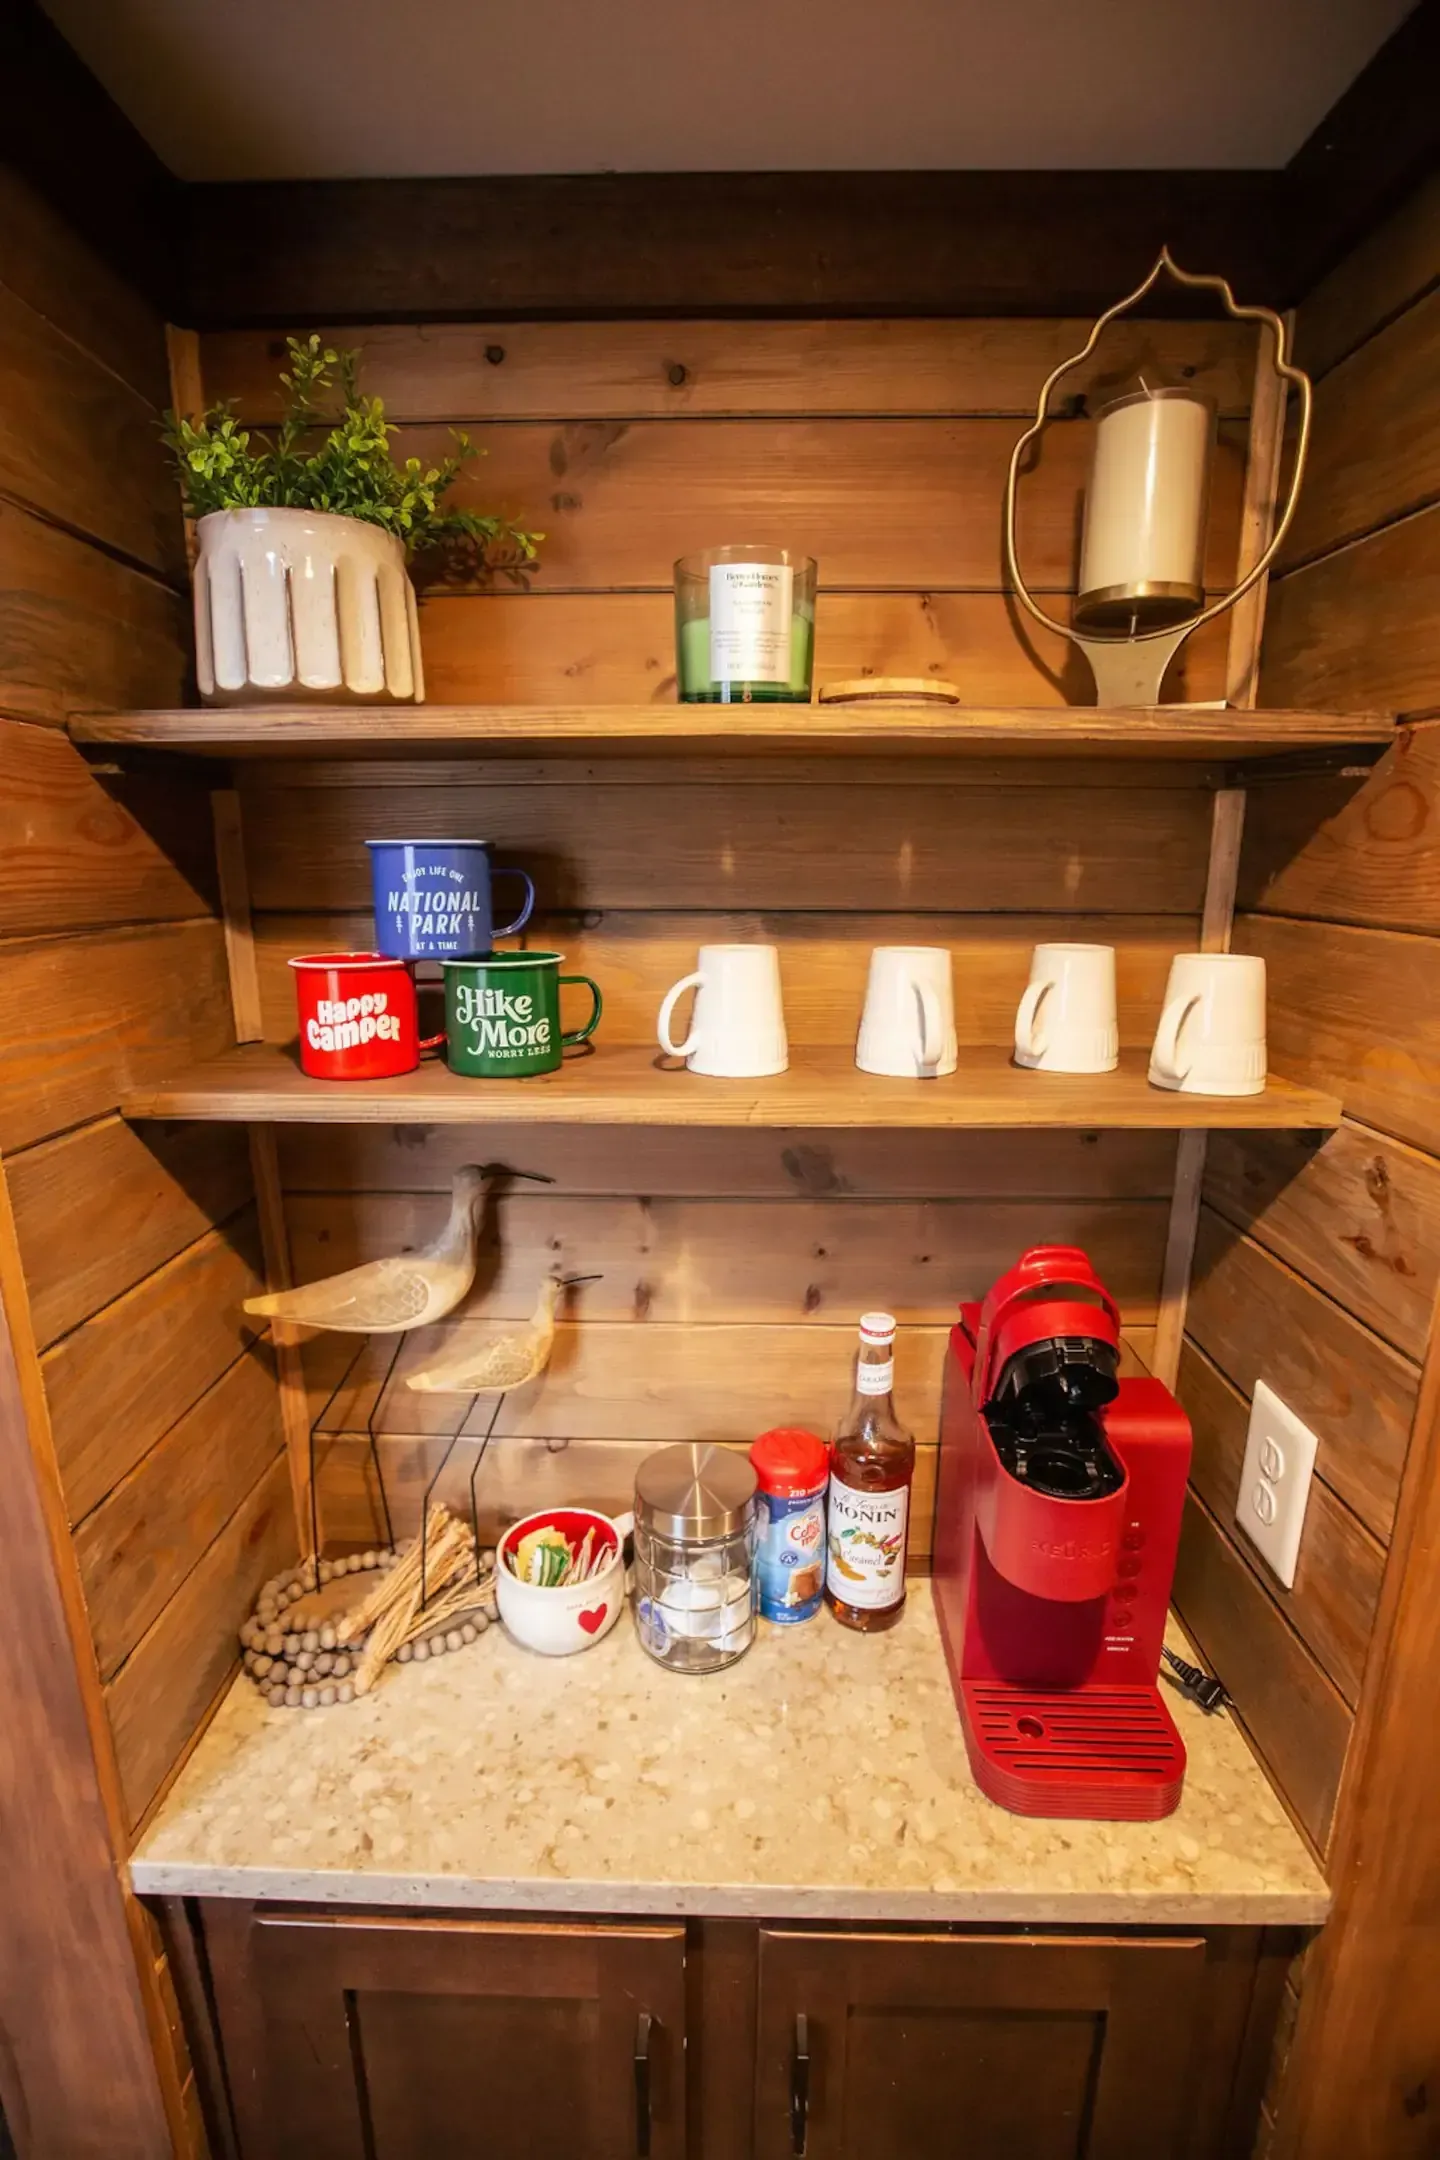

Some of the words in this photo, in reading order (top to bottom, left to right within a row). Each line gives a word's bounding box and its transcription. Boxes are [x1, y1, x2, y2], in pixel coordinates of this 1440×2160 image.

[429, 866, 447, 877] LIFE
[388, 891, 480, 912] NATIONAL
[411, 914, 463, 934] PARK
[438, 941, 458, 950] TIME
[317, 993, 388, 1025] Happy
[456, 985, 533, 1024] Hike
[306, 1014, 401, 1052] Camper
[467, 1017, 551, 1056] More
[488, 1049, 524, 1059] WORRY
[528, 1045, 551, 1056] LESS
[832, 1495, 897, 1523] MONIN
